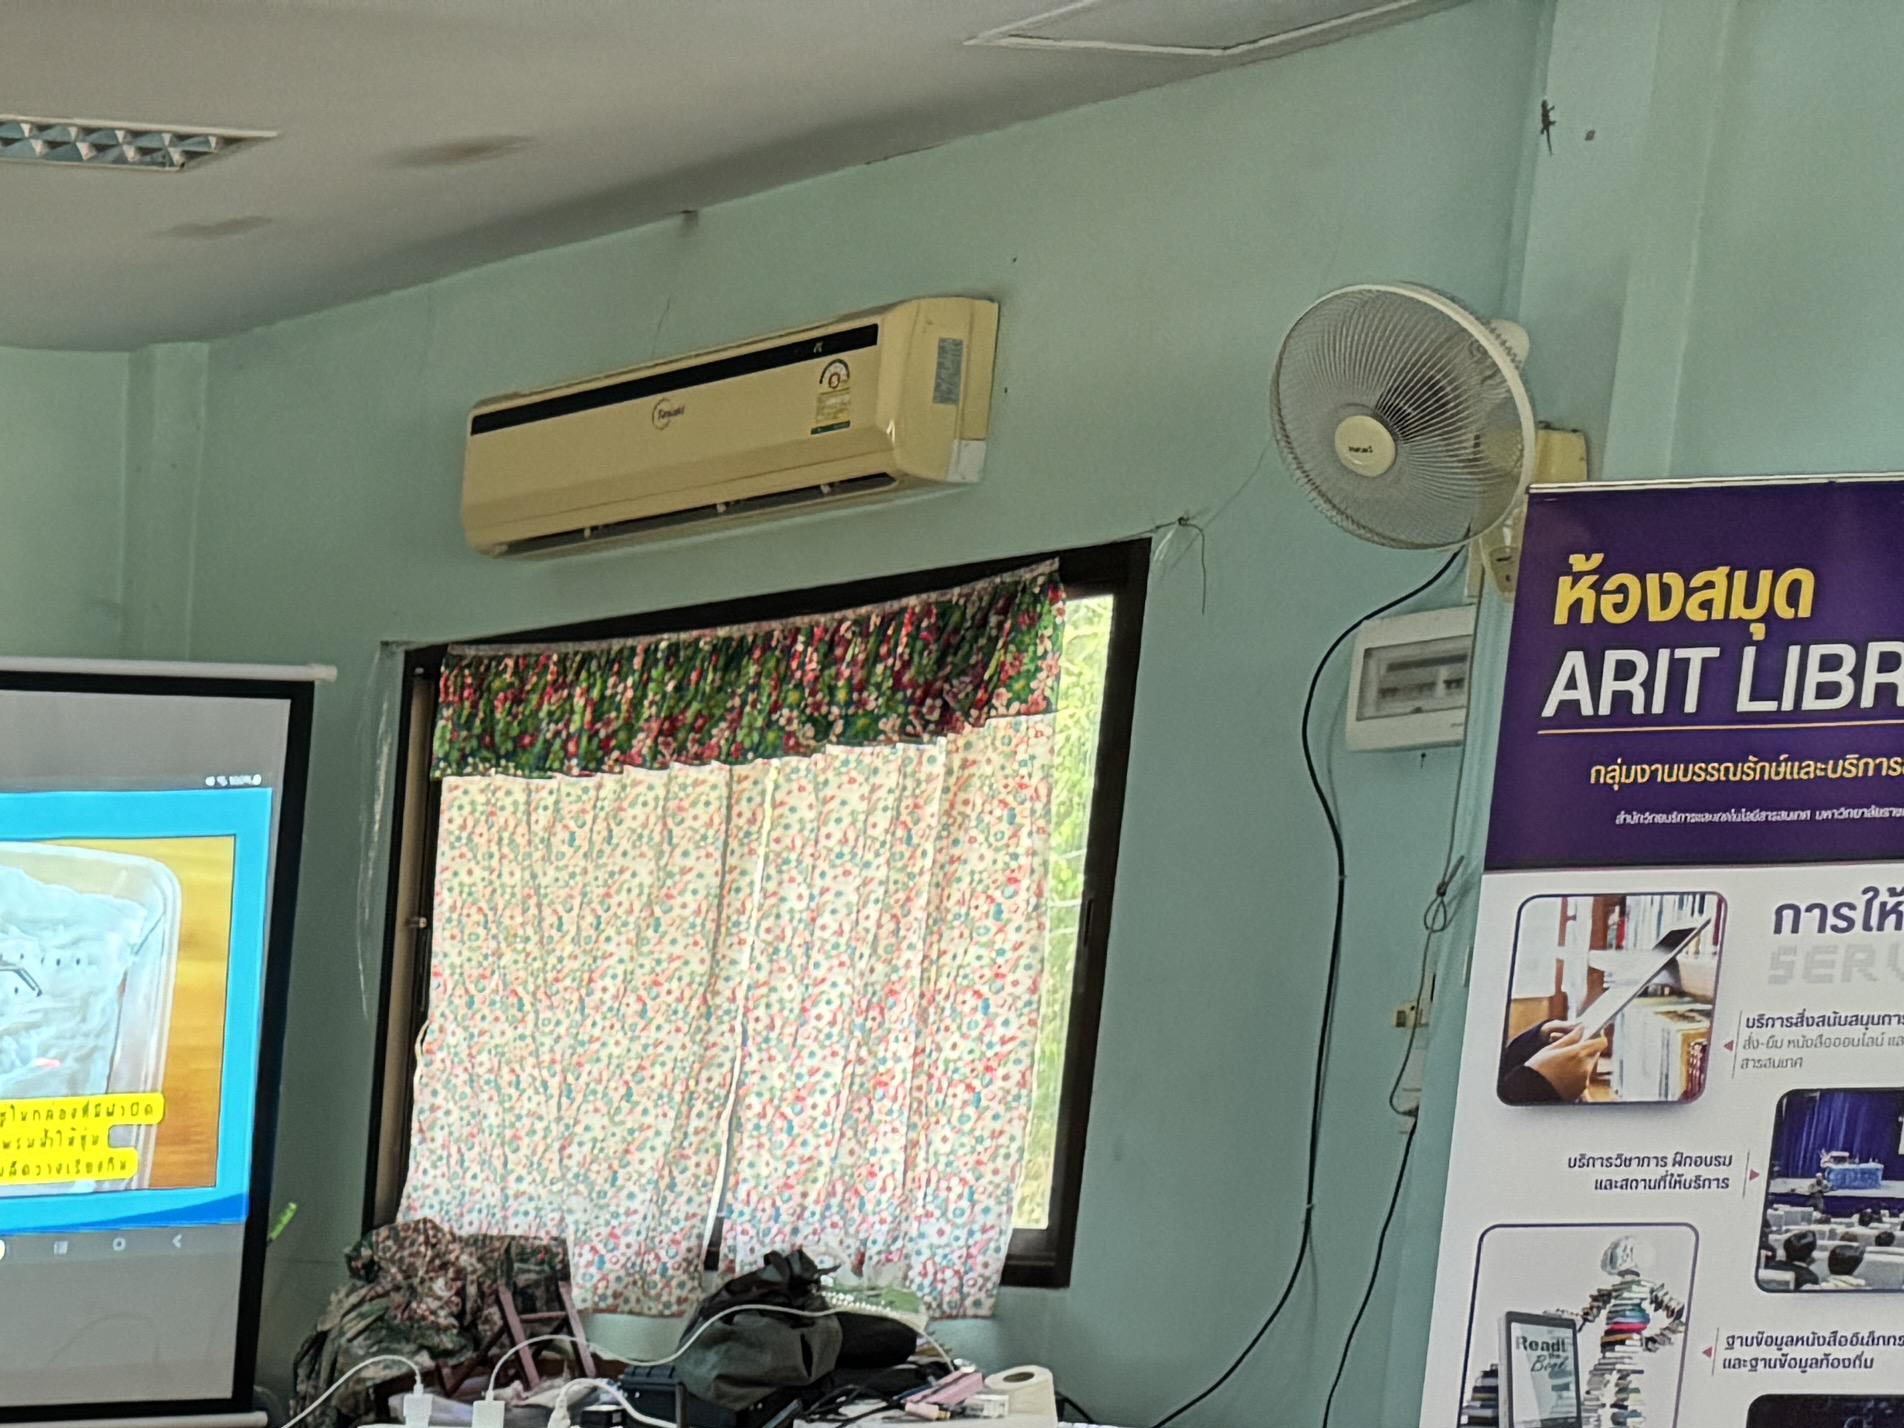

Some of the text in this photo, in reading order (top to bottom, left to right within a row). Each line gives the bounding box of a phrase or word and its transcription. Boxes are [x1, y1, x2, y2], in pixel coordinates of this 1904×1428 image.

[1553, 552, 1815, 640] ห้องสมุด
[1541, 645, 1720, 718] ARIT
[1590, 755, 1904, 790] กลุ่มงานบรรณรักษ์และบริการ
[1568, 1152, 1668, 1169] บริการวิชาการ
